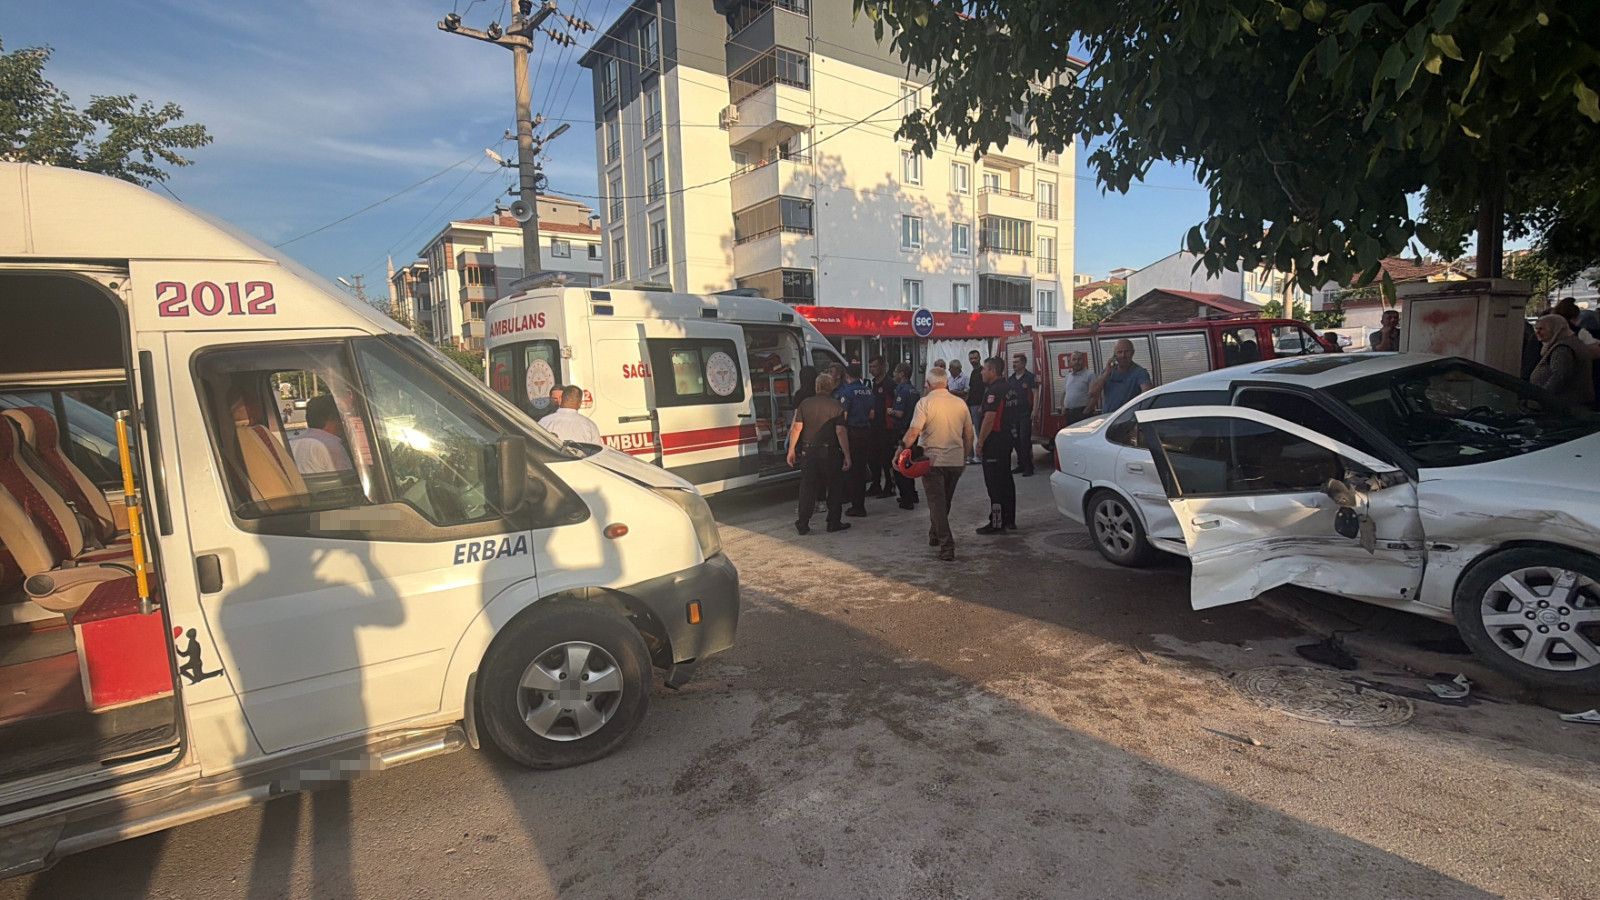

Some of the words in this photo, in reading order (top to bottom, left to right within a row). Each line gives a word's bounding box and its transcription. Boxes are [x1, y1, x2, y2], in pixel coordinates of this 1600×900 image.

[156, 281, 277, 317] 2012
[490, 312, 546, 338] AMBULANS
[622, 361, 652, 379] SAĞL
[453, 535, 528, 565] ERBAA
